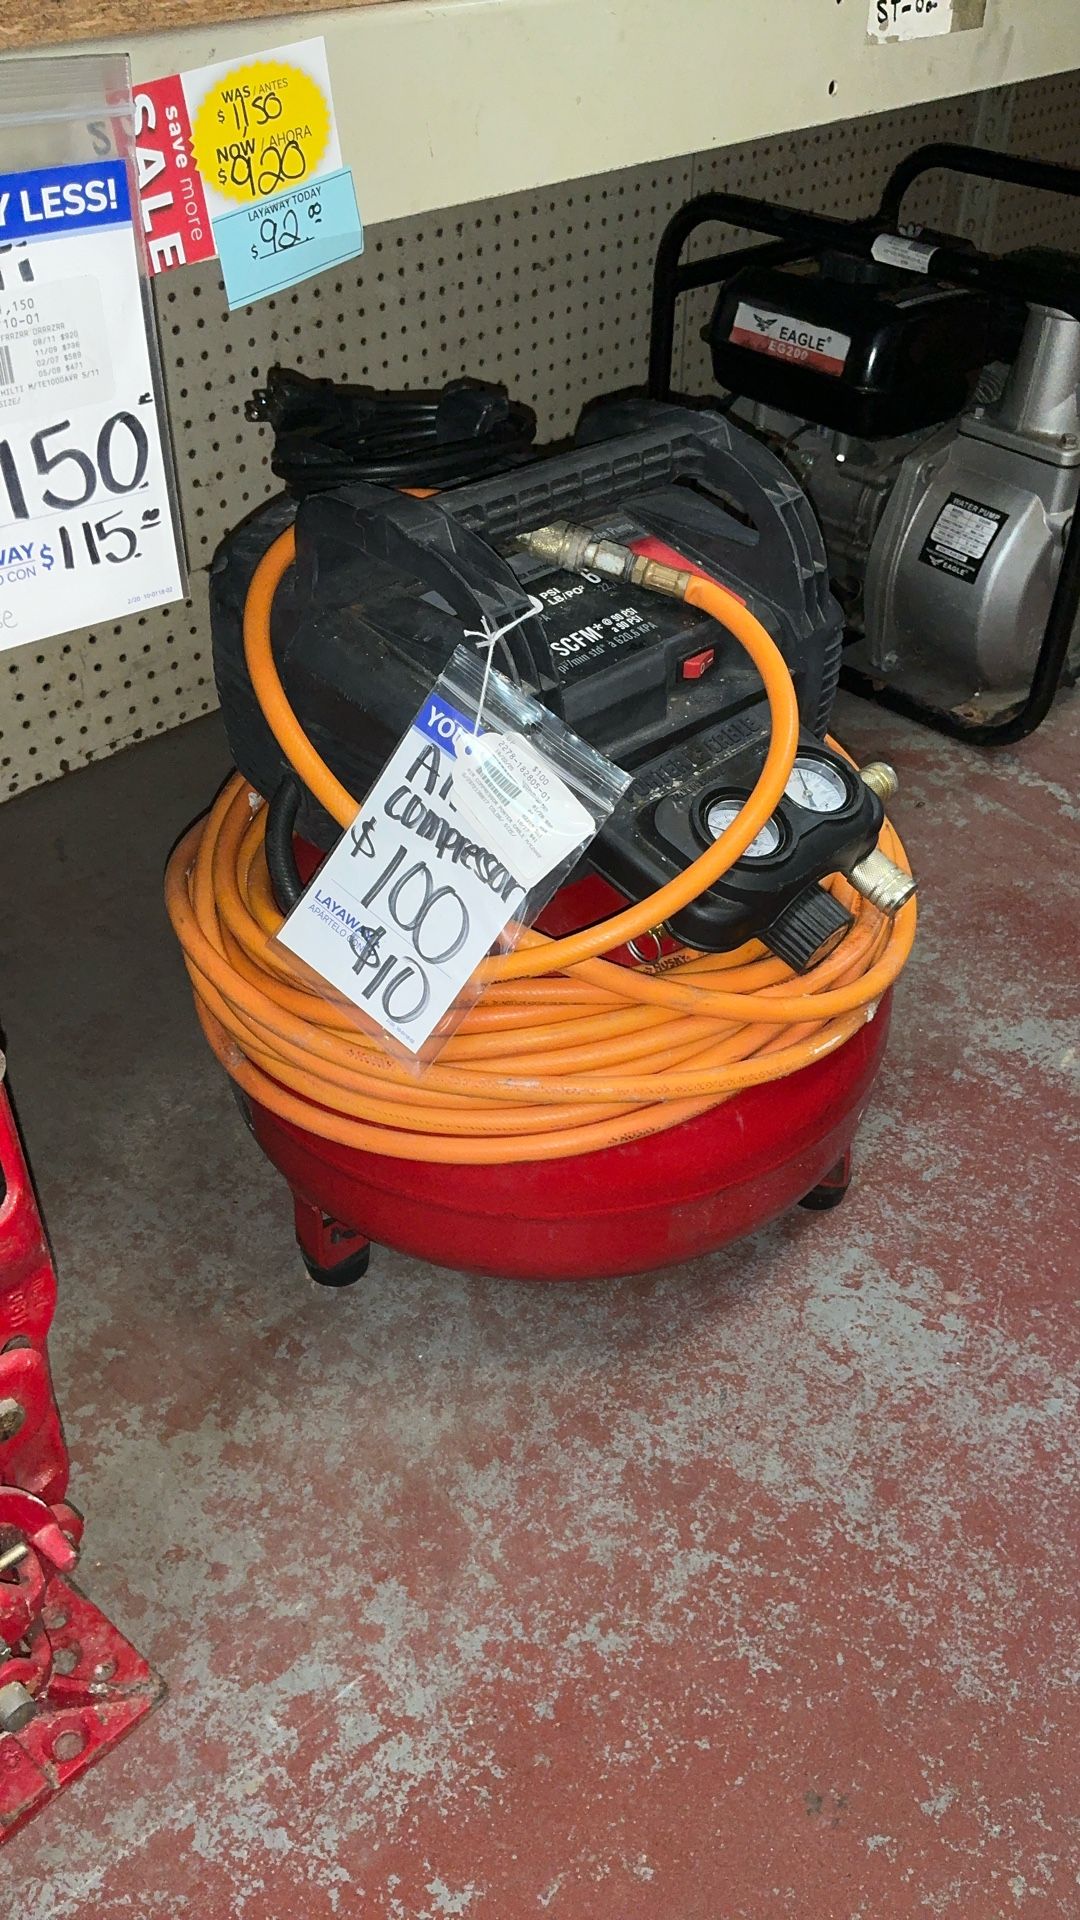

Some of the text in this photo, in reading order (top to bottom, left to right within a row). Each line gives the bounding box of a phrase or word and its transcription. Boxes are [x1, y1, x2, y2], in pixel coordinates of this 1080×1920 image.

[221, 85, 251, 103] WAS
[258, 77, 289, 94] ANTES
[216, 138, 255, 164] NOW
[269, 125, 312, 148] AHORA
[165, 105, 203, 242] save more
[217, 140, 306, 196] $920
[133, 93, 187, 274] SALE
[20, 178, 118, 222] LESS!
[248, 186, 322, 222] LAYAWAY TODAY
[0, 298, 35, 316] ,150
[767, 339, 808, 361] EG200
[778, 326, 825, 352] EAGLE
[0, 386, 24, 396] HILTI
[952, 497, 1001, 522] WATER PUMP
[7, 566, 37, 583] CON
[942, 561, 966, 576] EAGLE
[539, 587, 561, 600] PSI
[621, 607, 638, 618] PSI
[626, 615, 644, 625] PSI
[531, 765, 550, 786] $100
